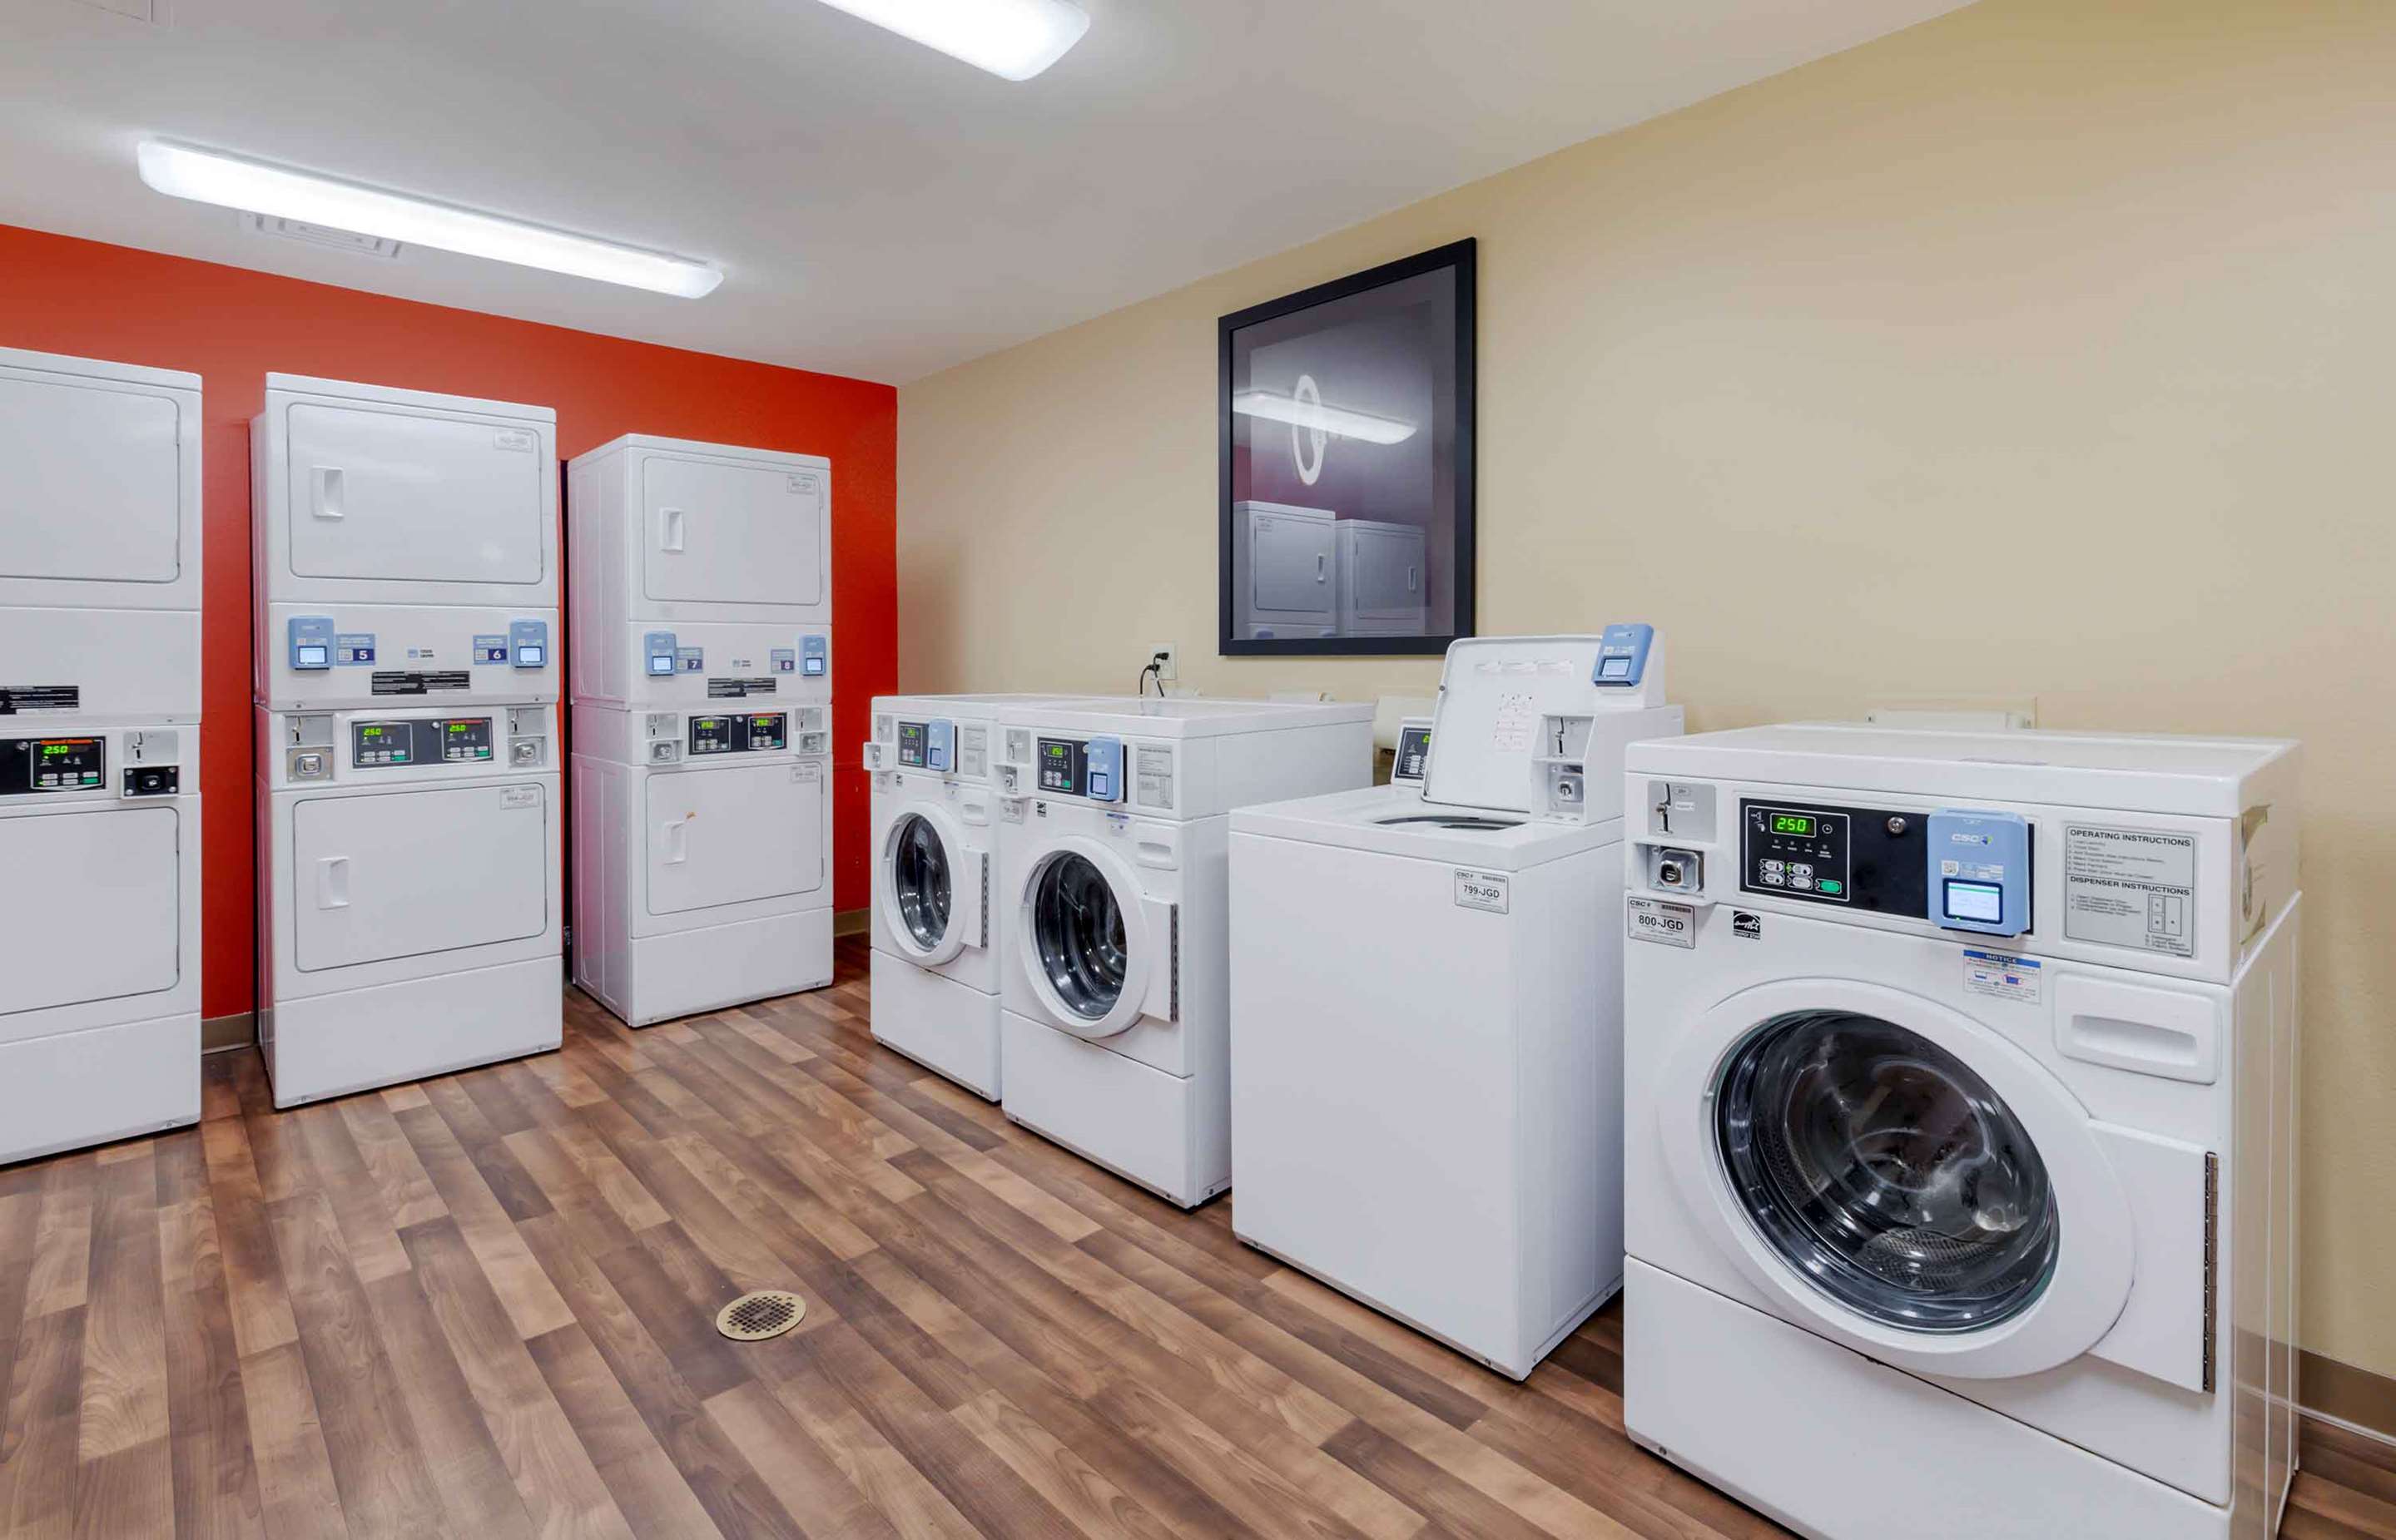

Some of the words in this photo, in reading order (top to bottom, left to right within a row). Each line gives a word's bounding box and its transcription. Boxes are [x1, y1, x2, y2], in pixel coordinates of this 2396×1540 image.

[359, 650, 368, 660] 5
[493, 650, 502, 660] 6
[692, 660, 697, 669] 7
[364, 728, 382, 736] 250
[43, 745, 68, 755] 250
[1777, 817, 1807, 832] 250
[1952, 833, 1980, 843] CSC
[2070, 829, 2120, 840] OPERATING
[2122, 834, 2191, 847] INSTRUCTIONS
[2070, 876, 2120, 888] DISPENSER
[2121, 882, 2190, 895] INSTRUCTIONS
[1464, 884, 1500, 899] 799-JGD
[1639, 914, 1684, 931] 800-JGD
[1986, 953, 2017, 963] NOTICE
